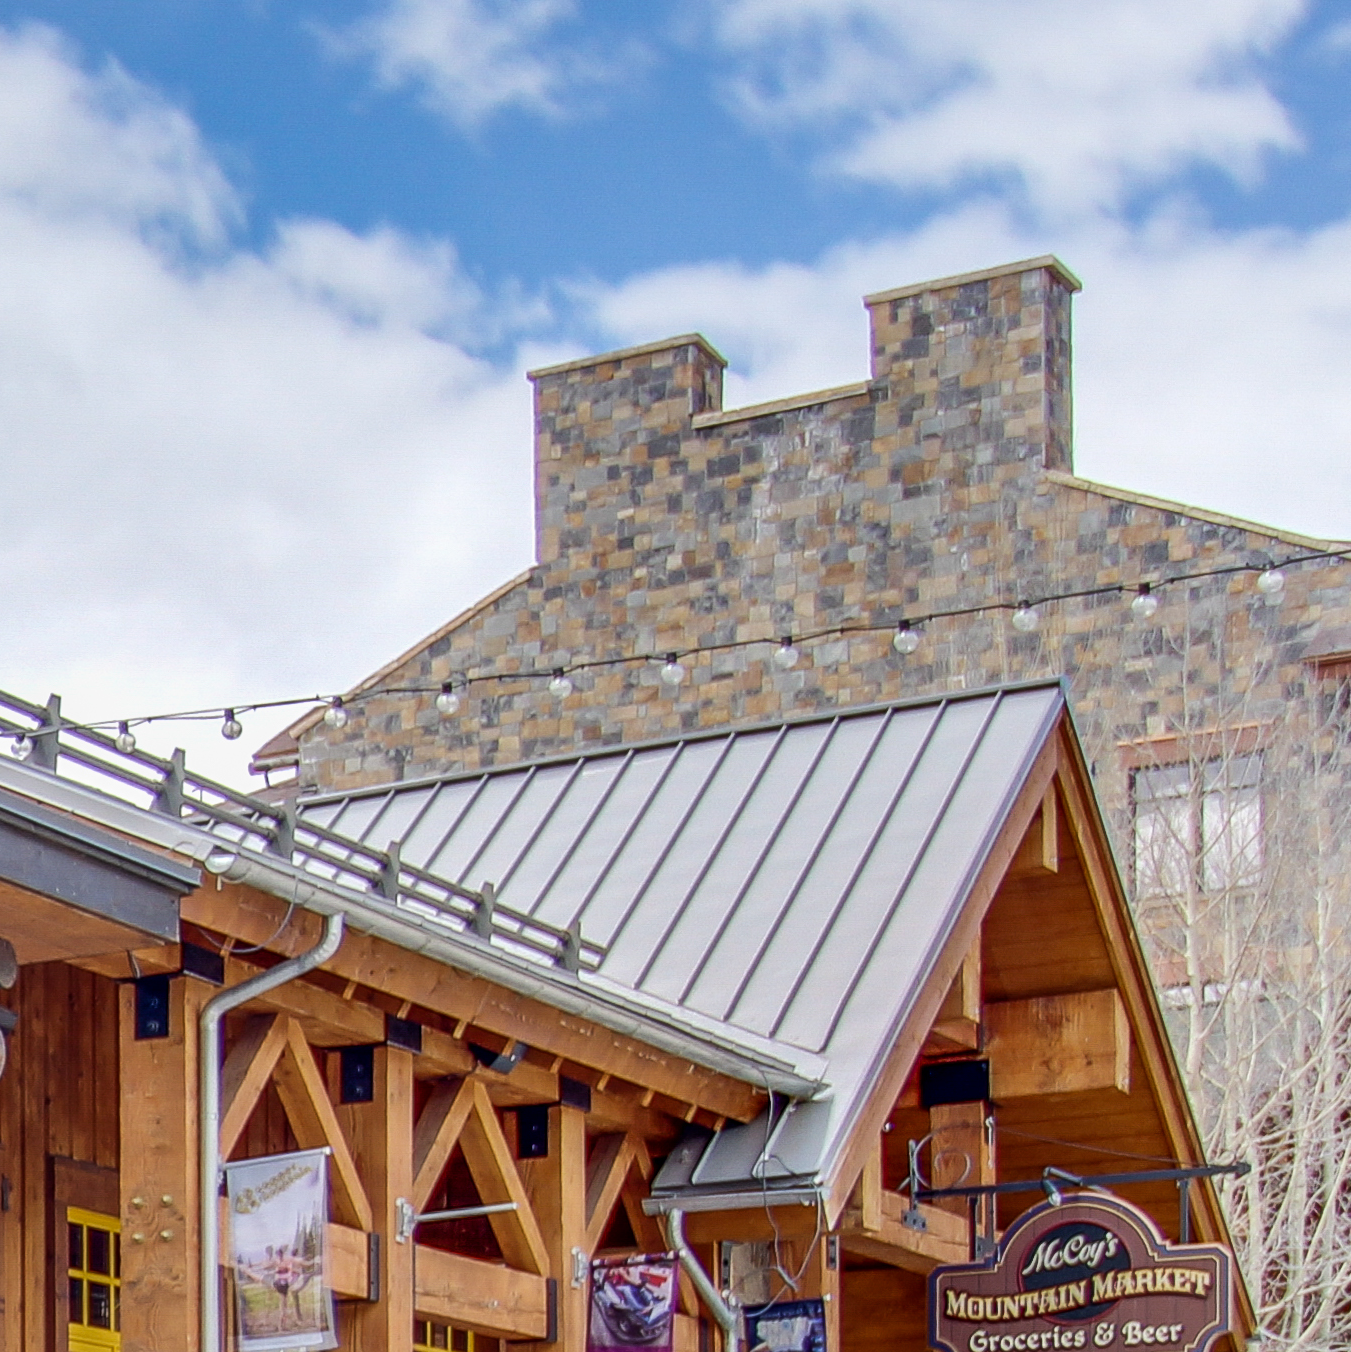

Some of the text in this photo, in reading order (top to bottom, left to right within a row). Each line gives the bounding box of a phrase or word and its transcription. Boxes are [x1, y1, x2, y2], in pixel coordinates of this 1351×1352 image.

[1022, 1232, 1118, 1276] McCoy's
[946, 1268, 1211, 1321] MOUNTAIN MARKET
[1094, 1322, 1114, 1346] &
[1122, 1321, 1183, 1345] Beer
